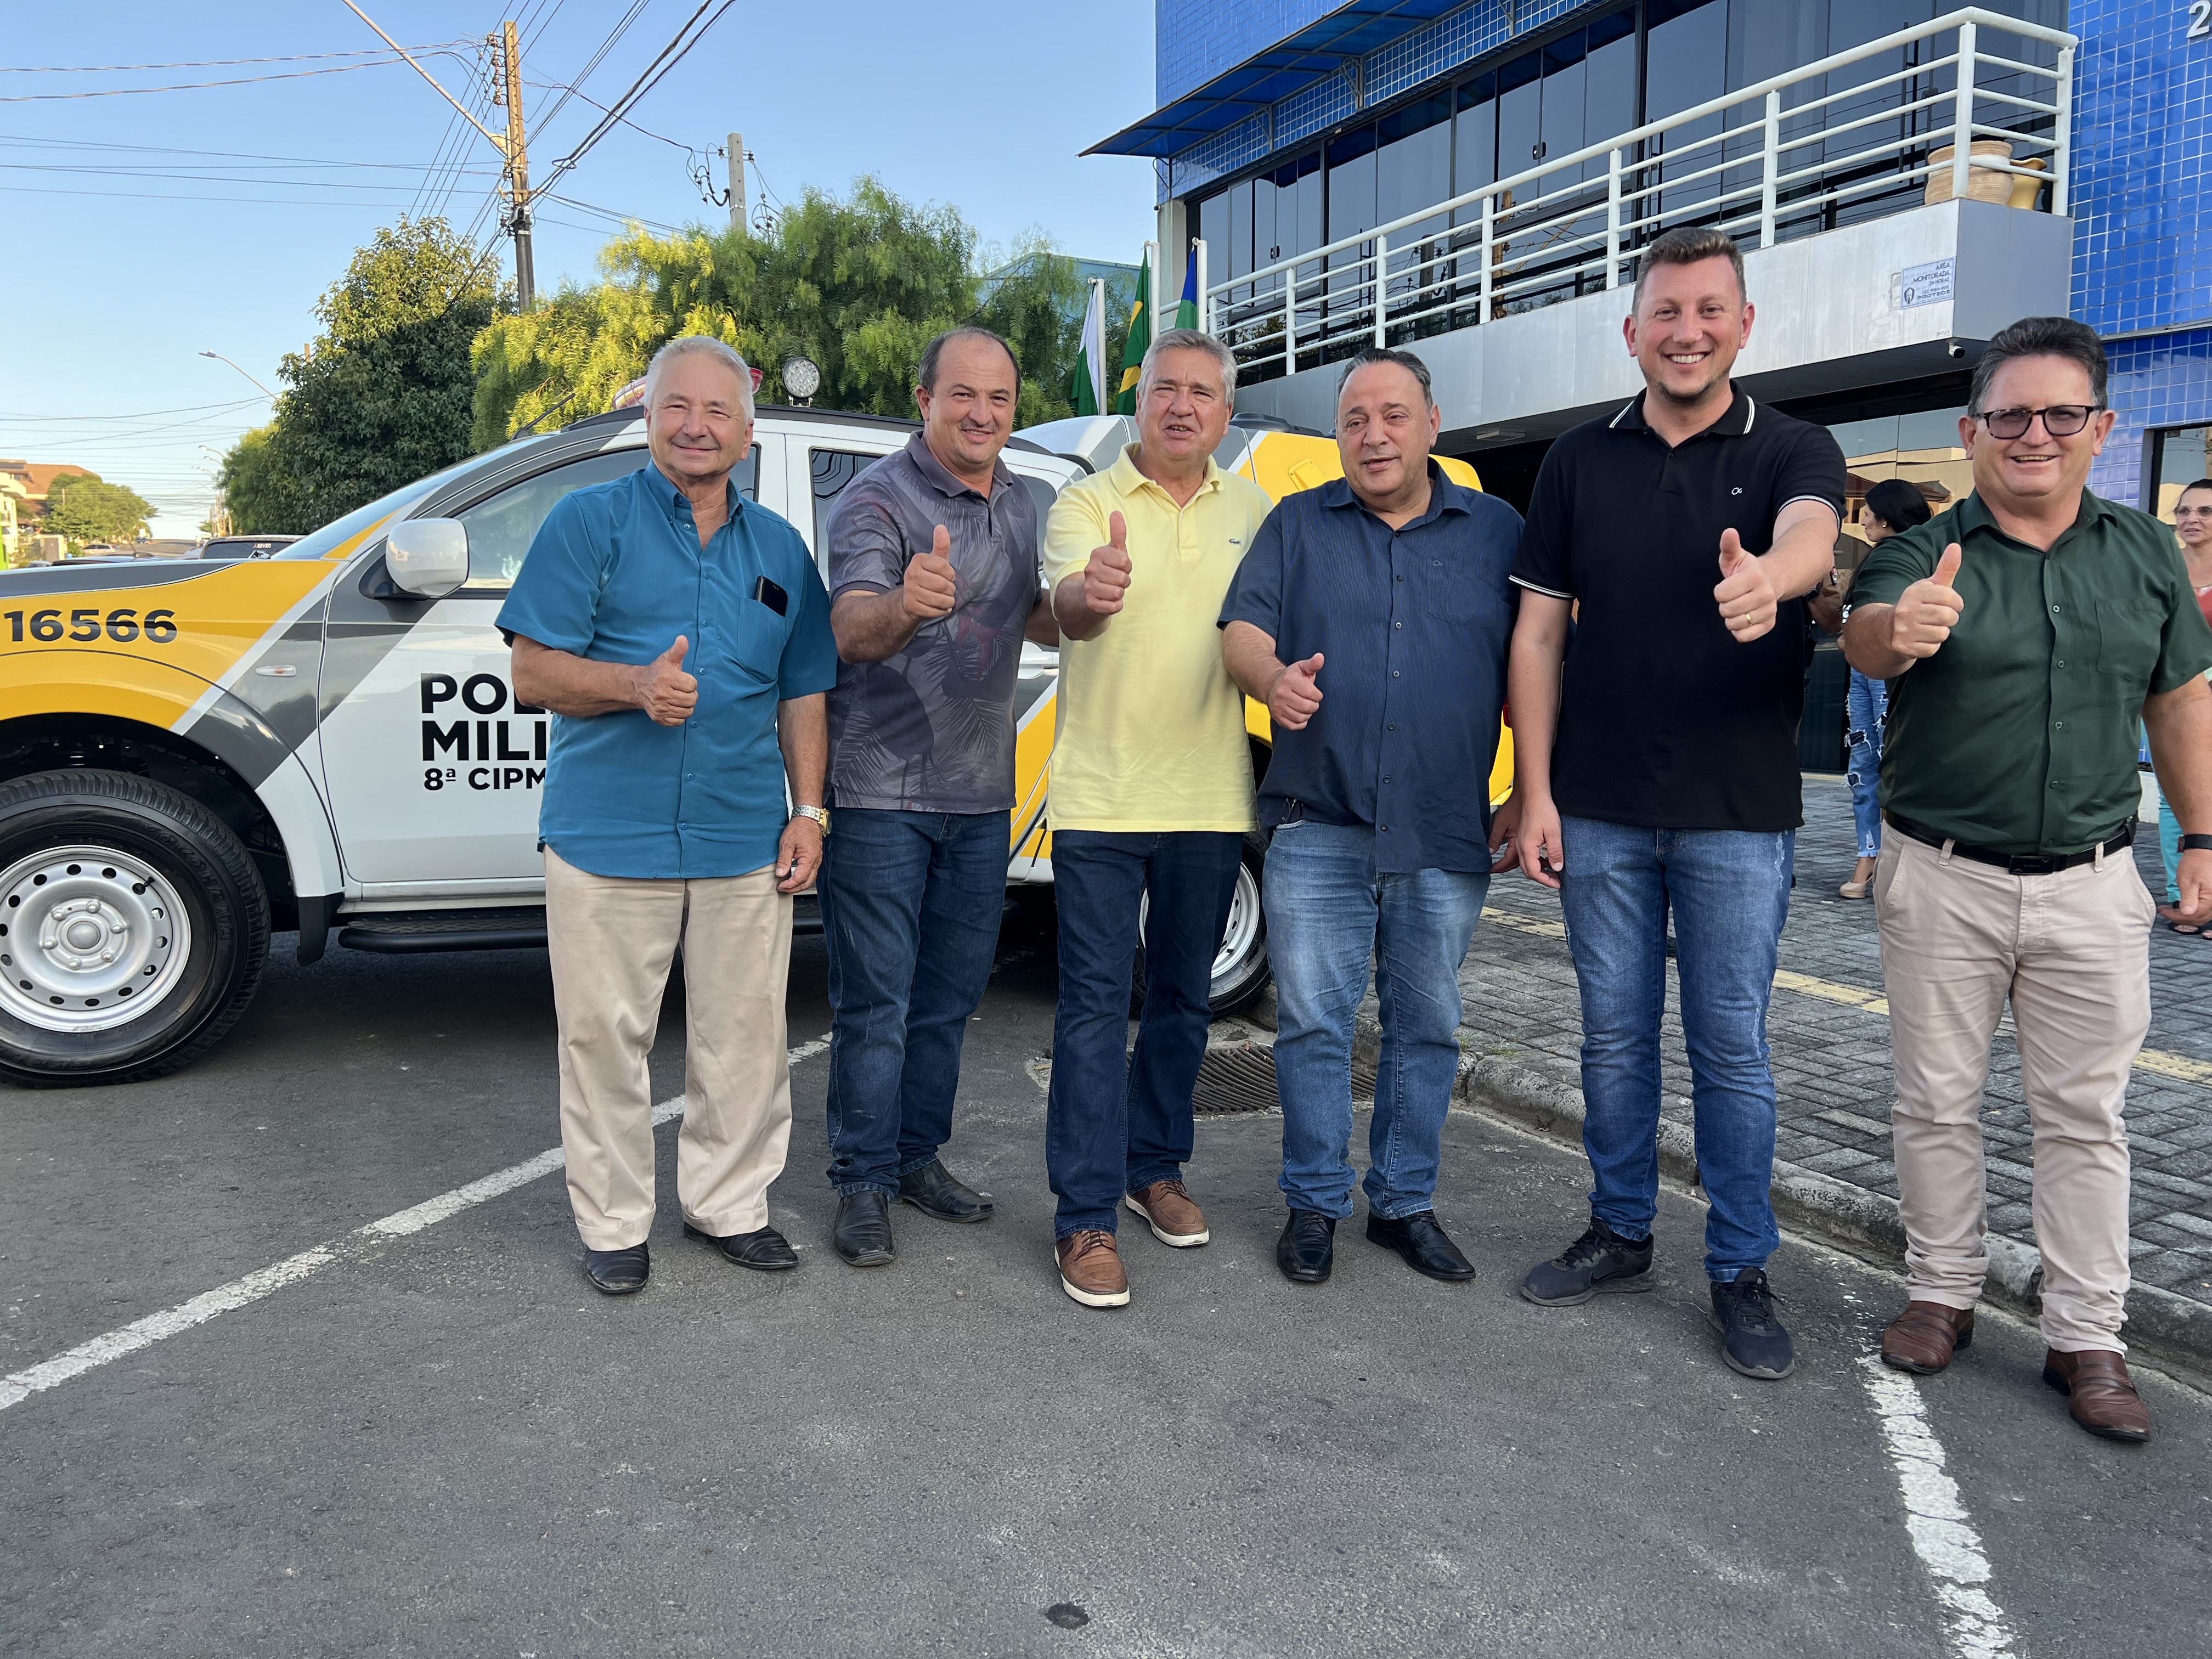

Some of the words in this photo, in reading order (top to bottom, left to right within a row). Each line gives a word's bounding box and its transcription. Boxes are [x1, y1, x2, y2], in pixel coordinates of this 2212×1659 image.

[2186, 0, 2211, 38] 2
[1914, 270, 1950, 283] MONITORADA
[3, 609, 177, 644] 16566
[422, 720, 547, 761] MILI
[424, 768, 456, 791] 8ª
[468, 768, 546, 790] CIPM
[142, 823, 233, 940] YOKOHAMA
